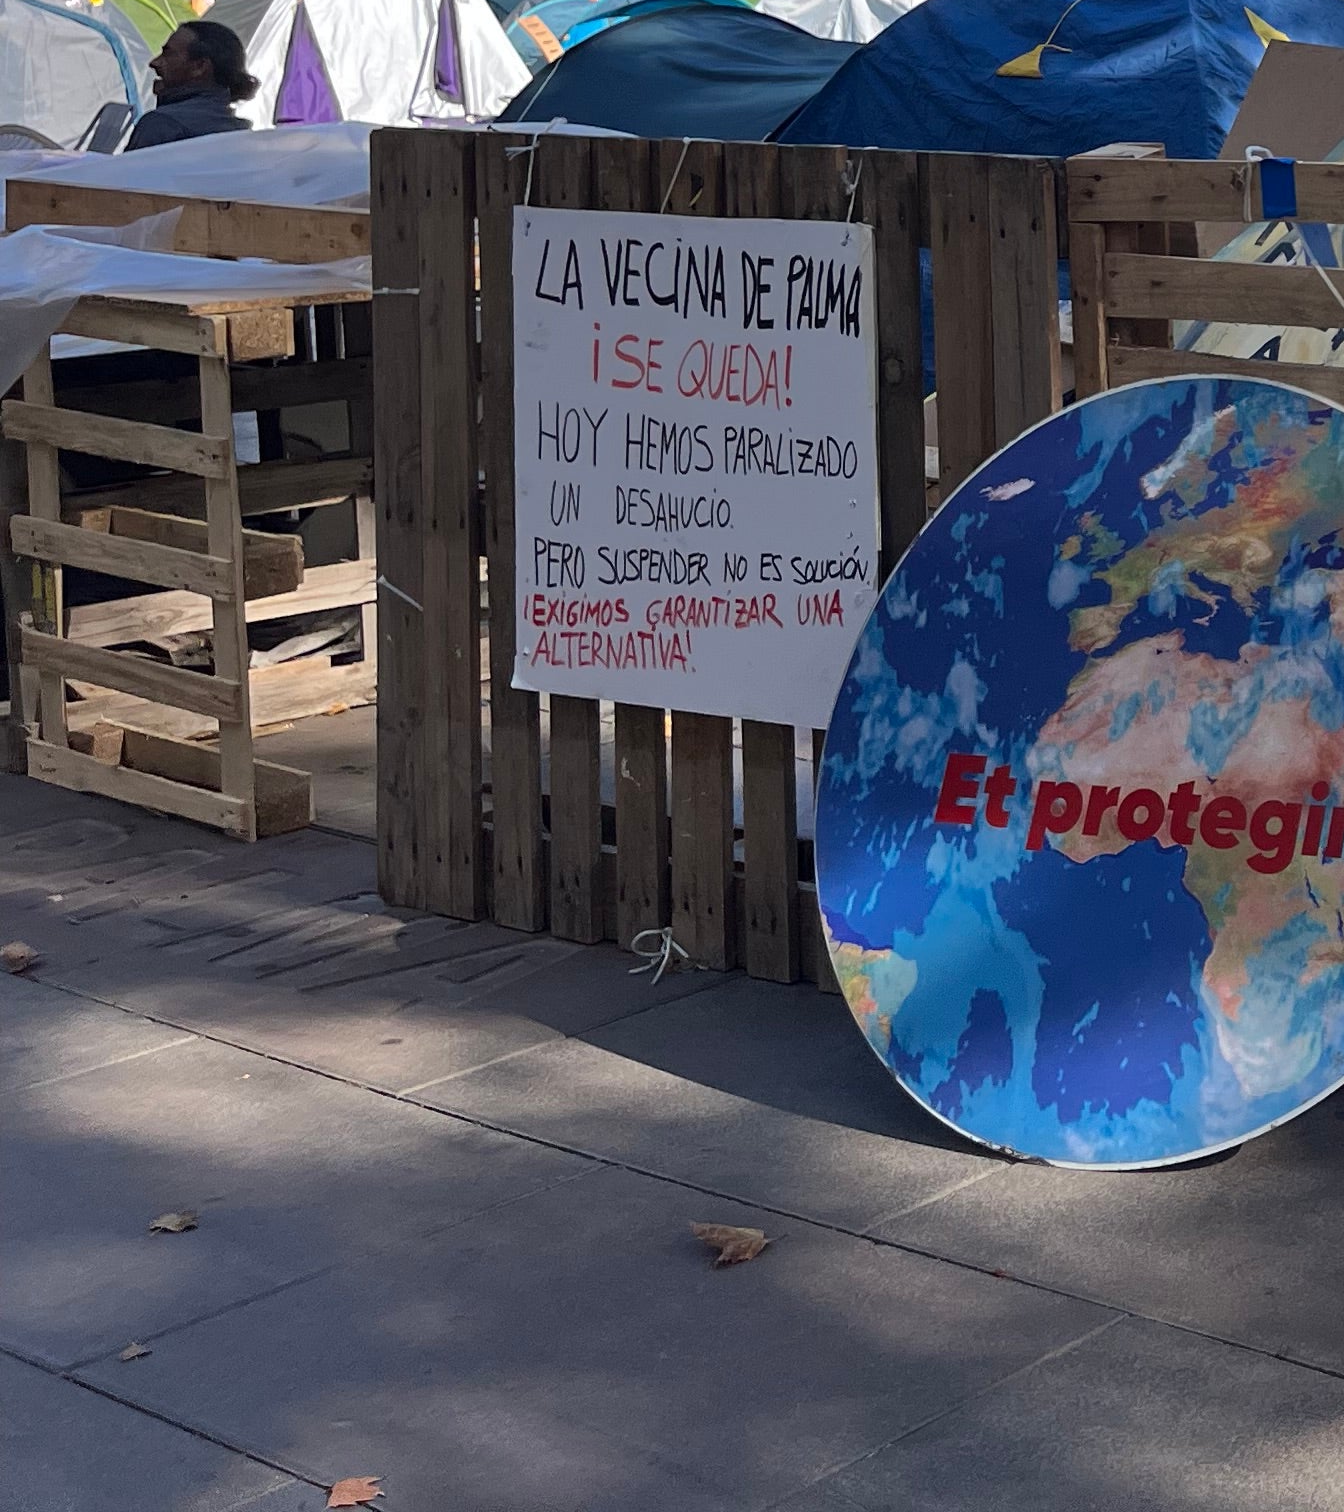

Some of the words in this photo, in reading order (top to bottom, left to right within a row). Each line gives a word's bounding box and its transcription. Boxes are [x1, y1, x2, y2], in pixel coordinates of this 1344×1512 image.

[535, 238, 583, 310] LA
[600, 237, 726, 319] VECINA
[741, 250, 774, 330] DE
[786, 254, 863, 338] PALMA
[677, 340, 793, 411] QUEDA!
[537, 400, 608, 466] HOY
[625, 413, 714, 475] HEMOS
[724, 425, 858, 479] PARALIZADO
[551, 480, 581, 526] UN
[534, 537, 585, 589] PERO
[598, 546, 711, 586] SUSPENDER
[724, 552, 748, 584] NO
[760, 553, 783, 582] ES
[646, 590, 784, 631] GARANTIZAR
[797, 589, 844, 627] UNA
[531, 629, 696, 673] ALTERNATIVA!
[934, 752, 1017, 829] Et
